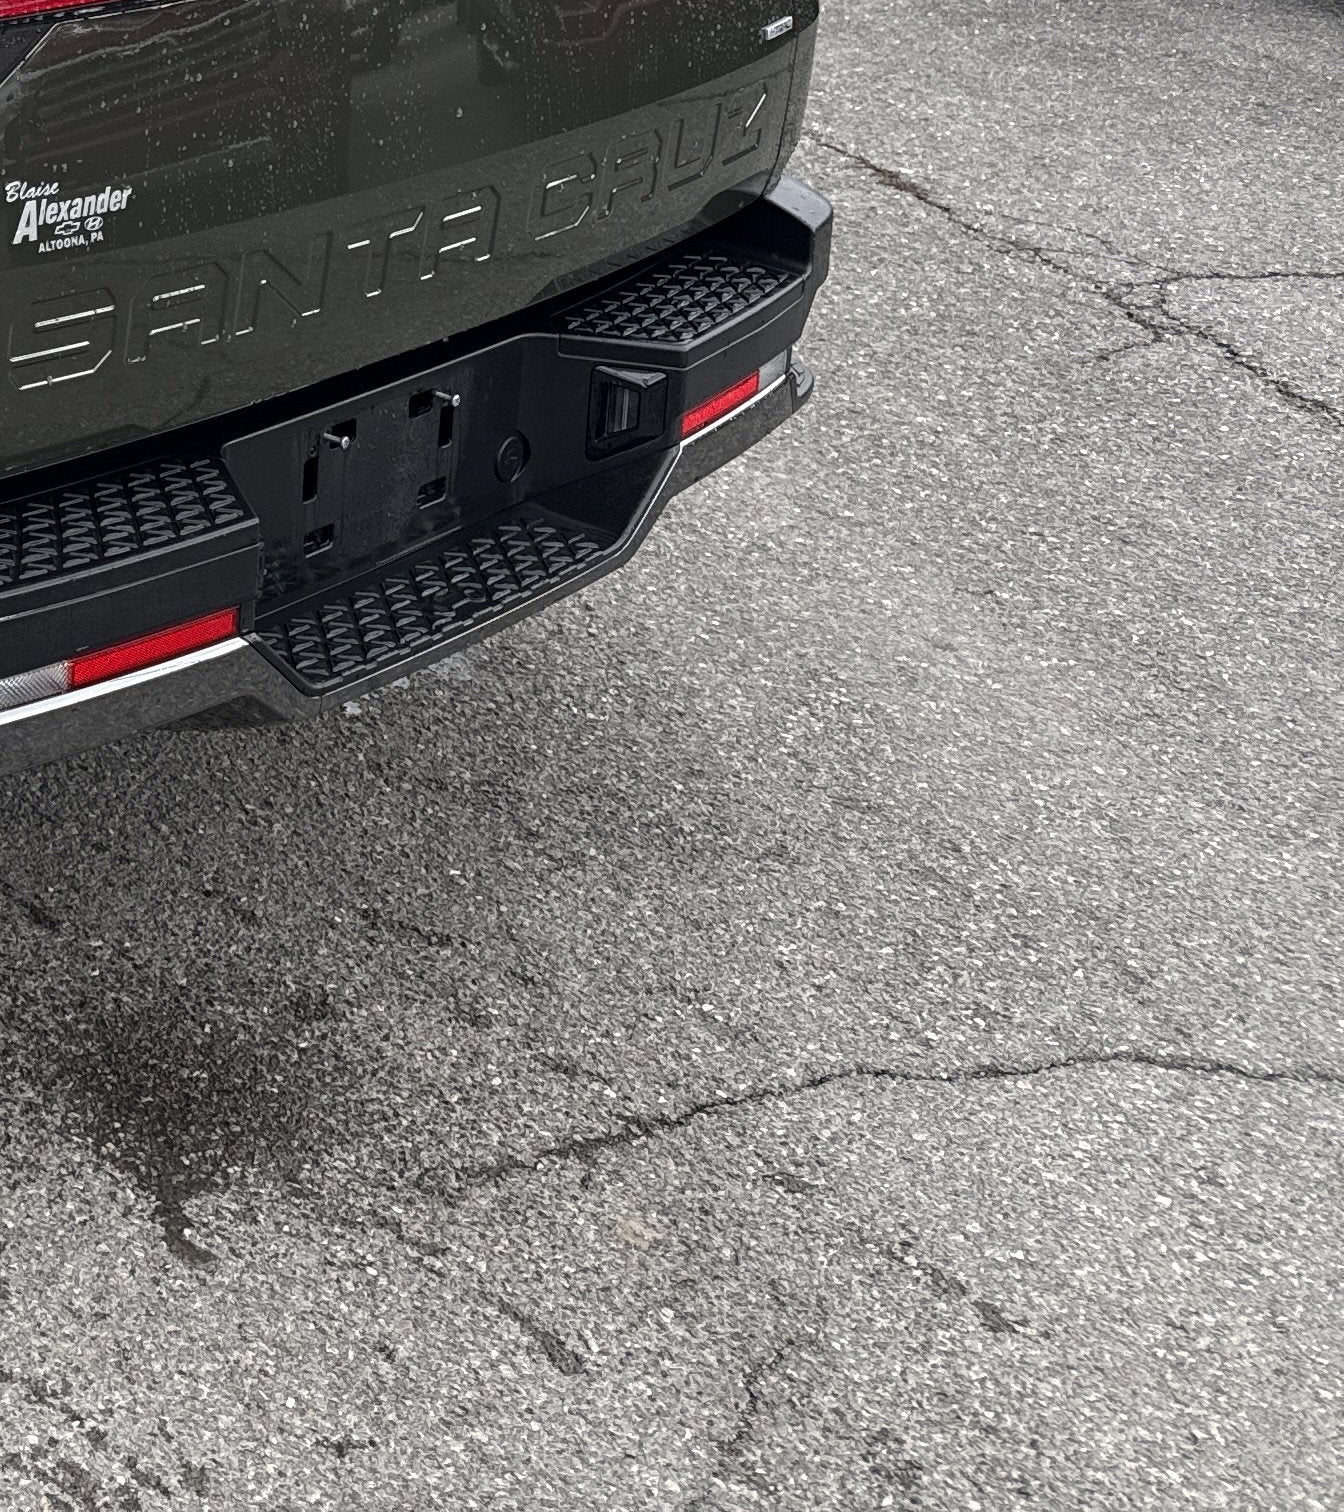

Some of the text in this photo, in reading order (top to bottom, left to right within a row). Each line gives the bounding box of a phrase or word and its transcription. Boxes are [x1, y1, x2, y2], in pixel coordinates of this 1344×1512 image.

[5, 180, 60, 203] Blaise
[12, 186, 132, 245] Alexander
[8, 85, 769, 391] SANTA CRUZ
[38, 231, 104, 254] ALTOONA, PA
